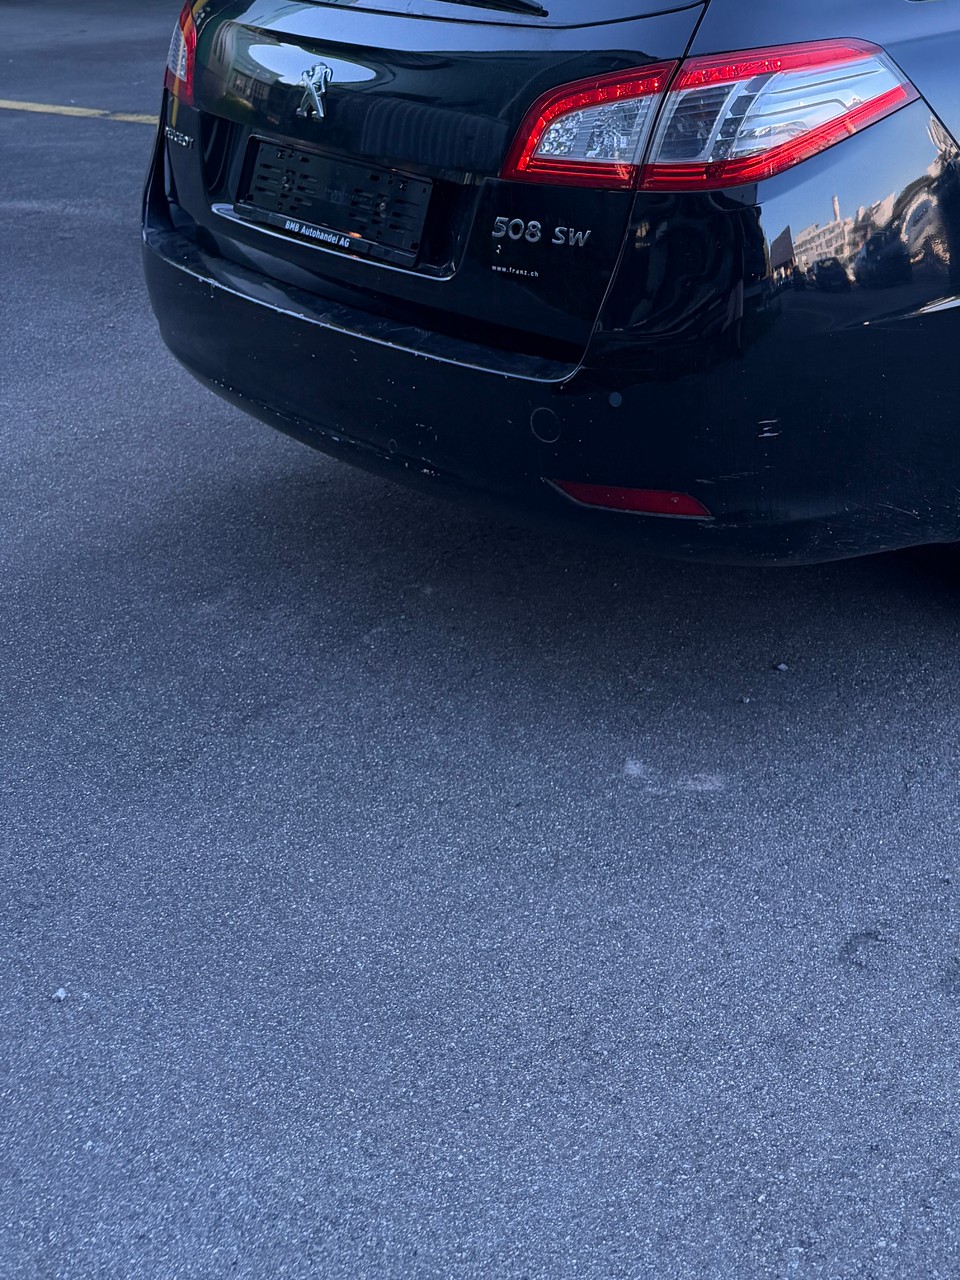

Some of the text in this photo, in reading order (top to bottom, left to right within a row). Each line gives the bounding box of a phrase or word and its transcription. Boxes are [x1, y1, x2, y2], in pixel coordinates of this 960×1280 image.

[285, 220, 351, 248] BMB Autohandel AG
[491, 216, 592, 247] 508 SW
[491, 265, 539, 277] www.franz.ch
